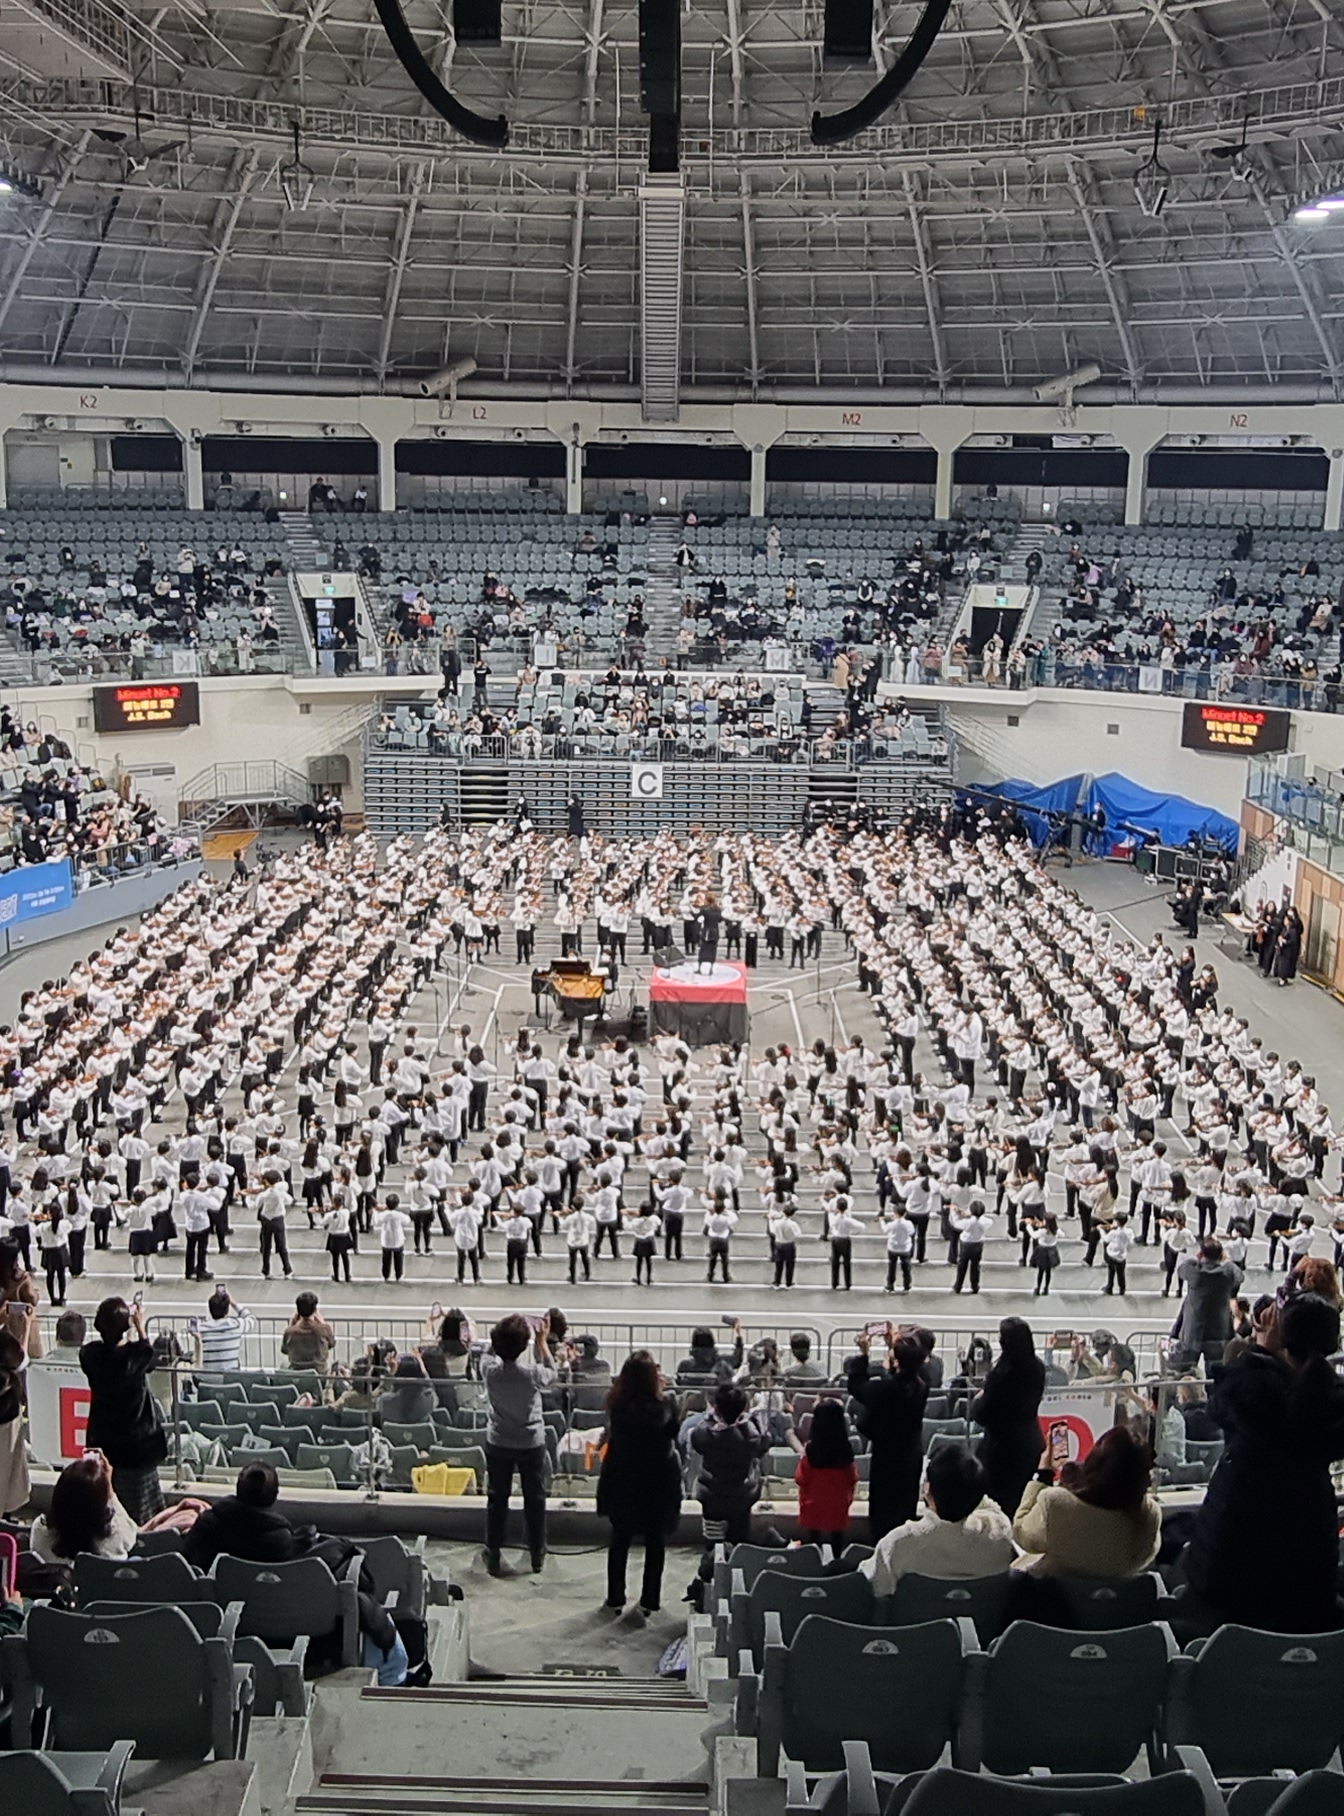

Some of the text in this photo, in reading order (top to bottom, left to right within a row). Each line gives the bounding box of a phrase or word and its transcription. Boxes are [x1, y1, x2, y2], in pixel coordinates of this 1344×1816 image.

[80, 395, 97, 409] K2
[473, 406, 487, 420] L2
[842, 413, 862, 426] M2
[1229, 414, 1248, 428] N2
[637, 771, 658, 795] C
[59, 1387, 92, 1459] E
